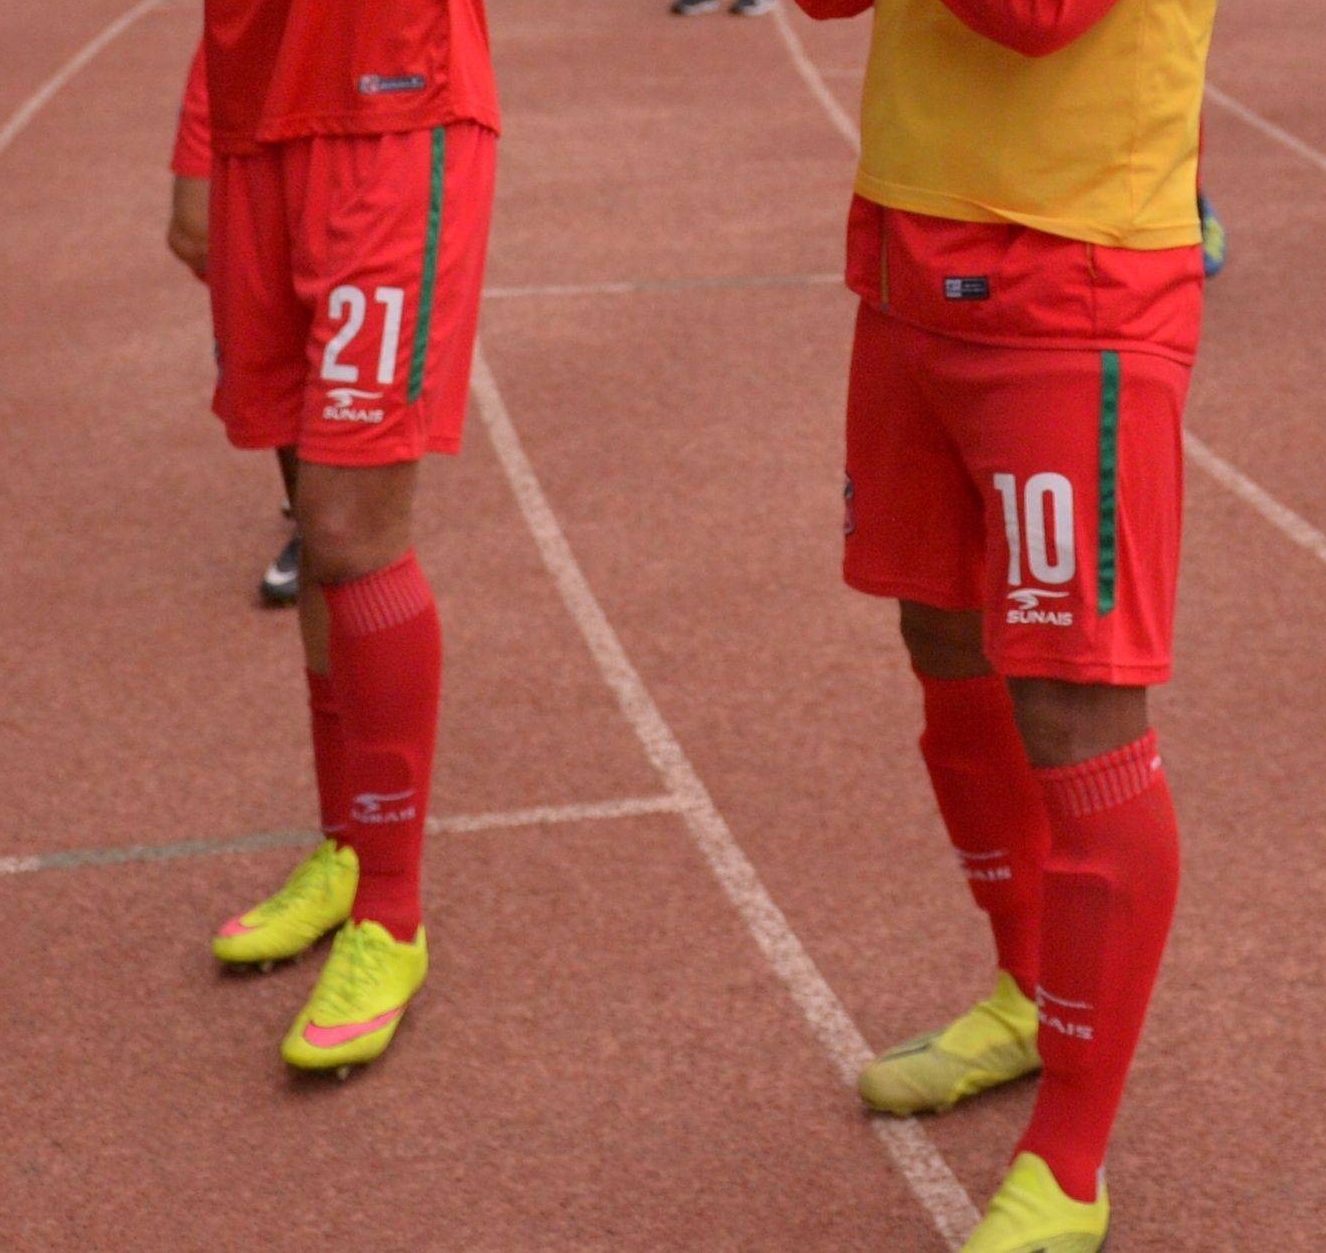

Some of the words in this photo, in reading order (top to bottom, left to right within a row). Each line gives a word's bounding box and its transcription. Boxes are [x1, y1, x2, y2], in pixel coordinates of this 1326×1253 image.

[320, 285, 405, 384] 21
[993, 471, 1076, 586] 10
[1006, 608, 1073, 627] SUNAIS
